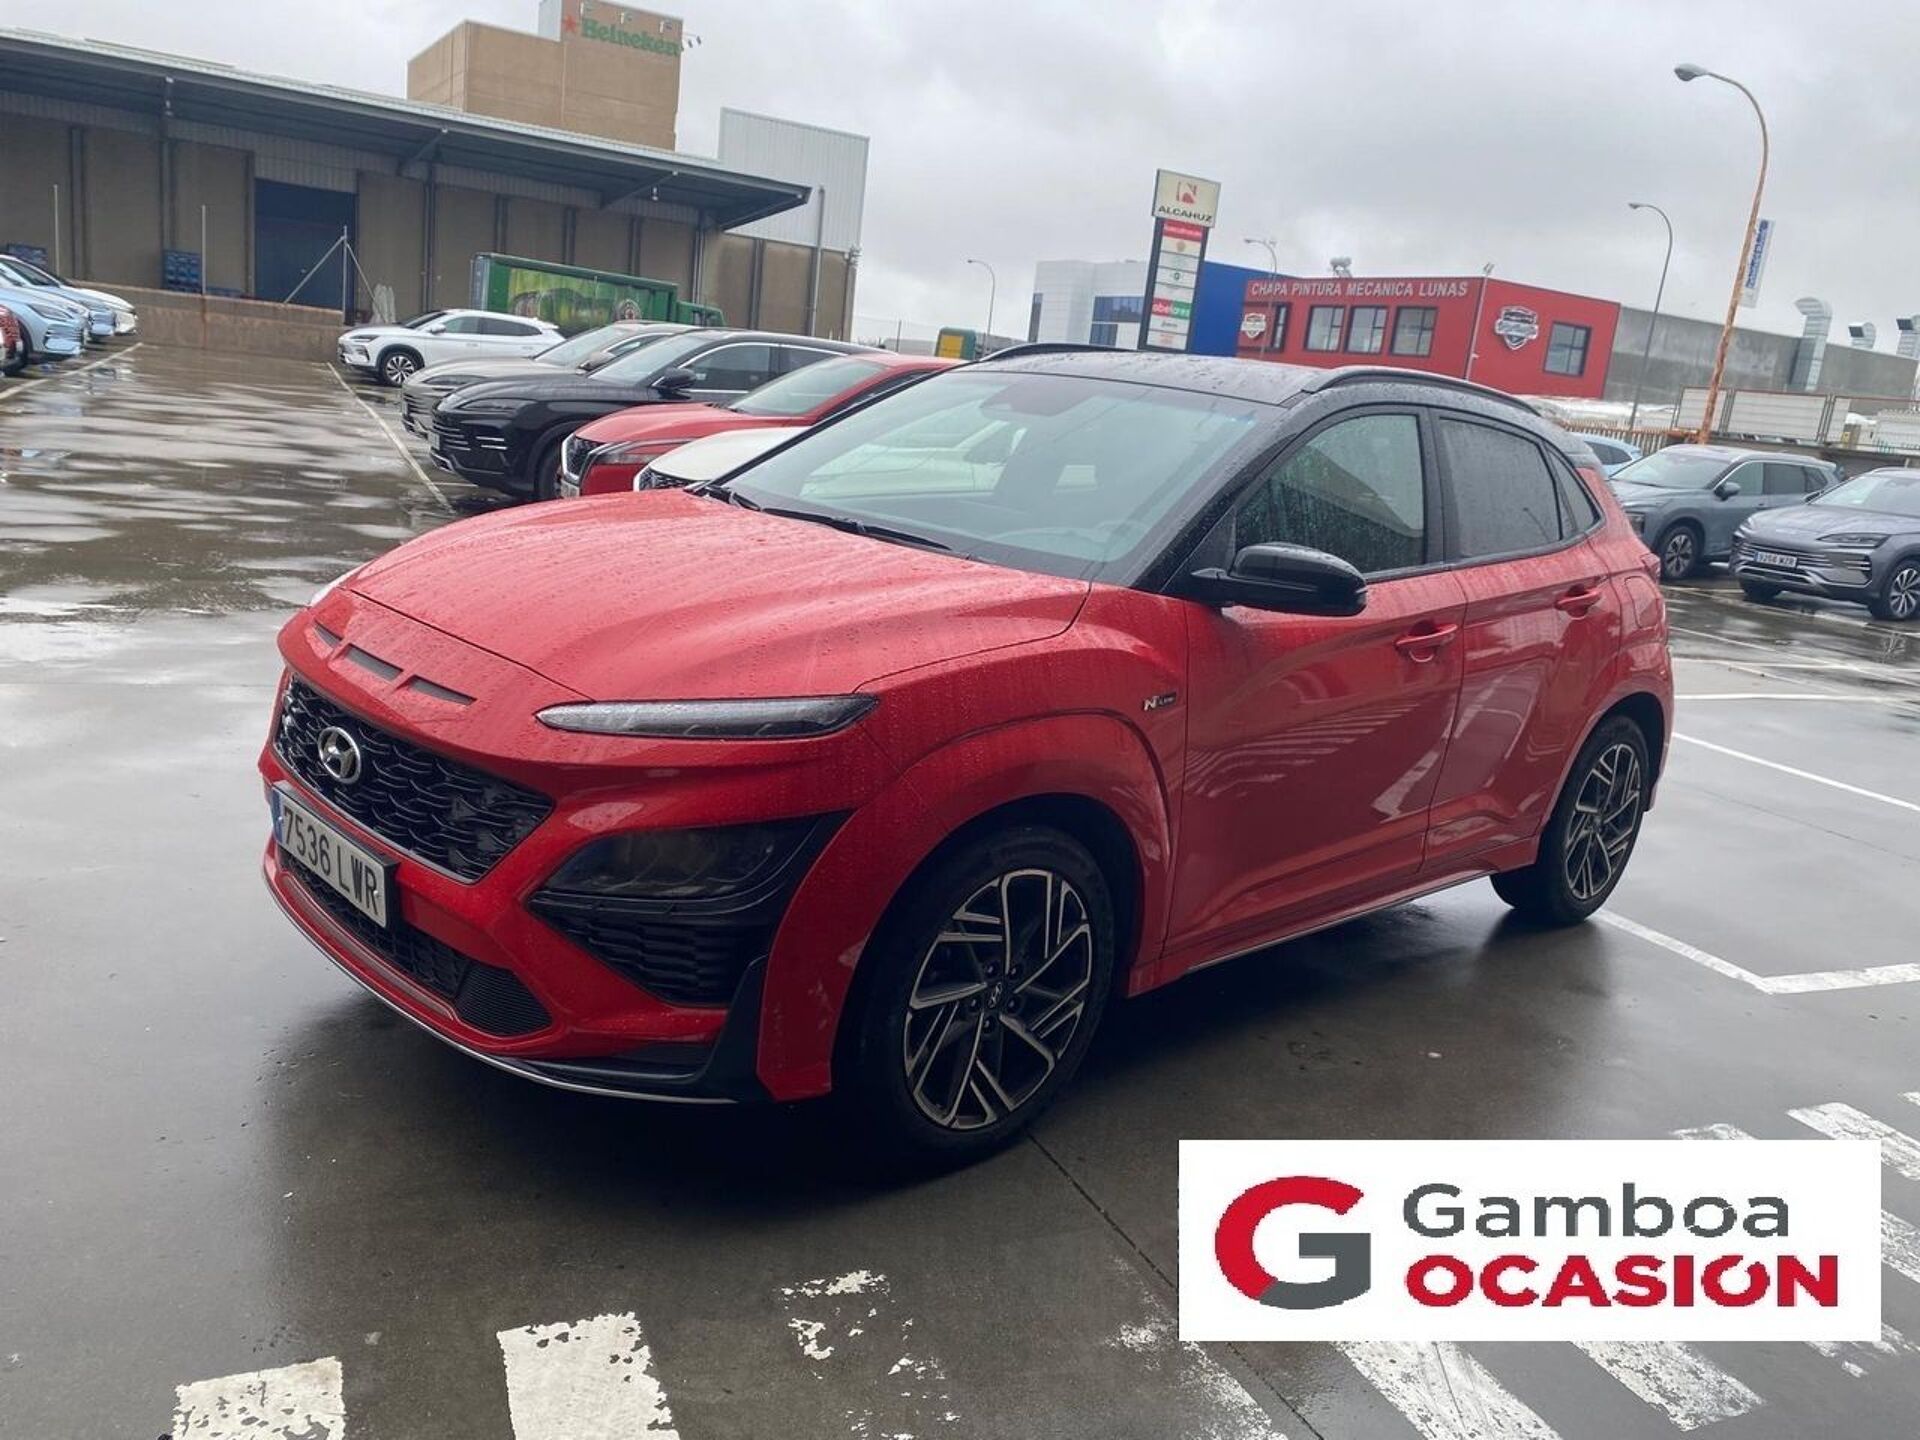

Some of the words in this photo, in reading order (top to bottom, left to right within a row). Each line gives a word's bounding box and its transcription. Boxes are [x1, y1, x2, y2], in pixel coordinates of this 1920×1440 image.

[581, 17, 681, 56] Heineken
[1158, 205, 1212, 221] ALCAHUZ
[1251, 281, 1288, 296] CHAPA
[1291, 281, 1342, 296] PINTURA
[1345, 281, 1414, 297] MECANICA
[1418, 281, 1469, 297] LUNAS
[283, 805, 331, 876] 7536
[337, 845, 378, 916] LWR
